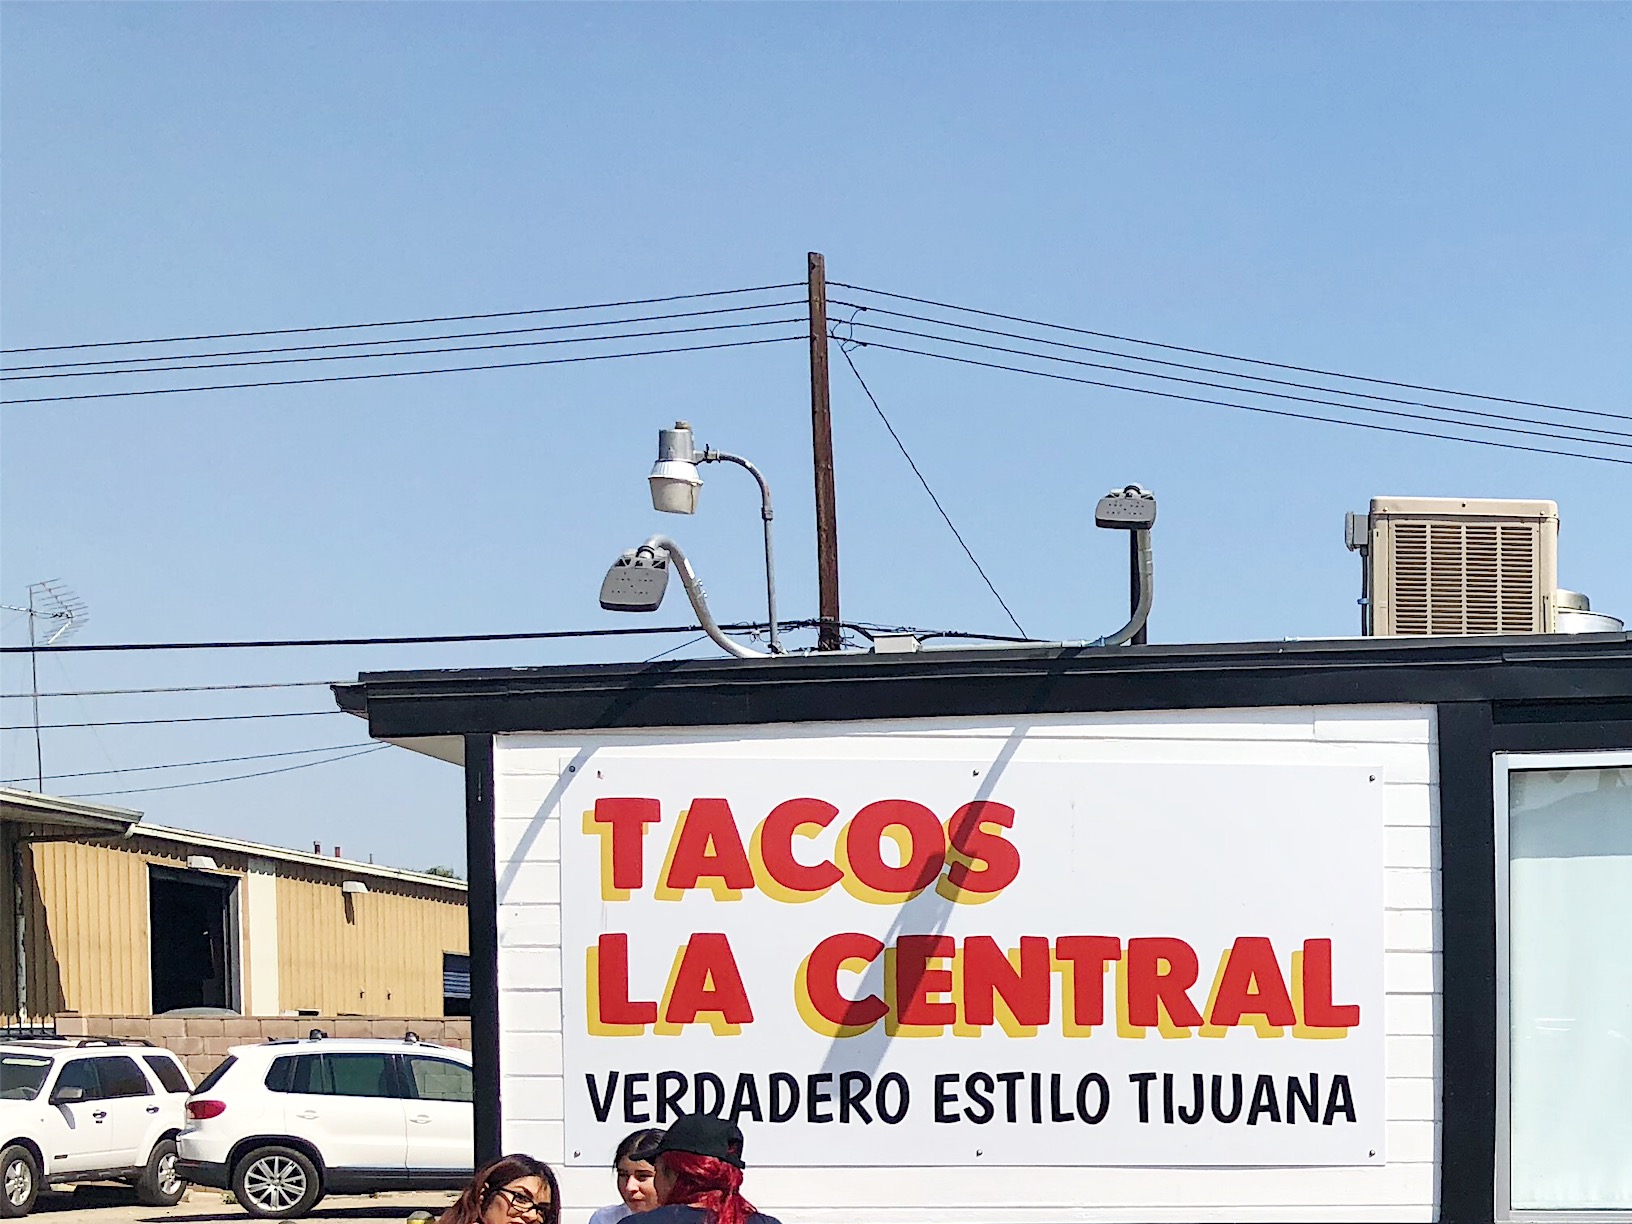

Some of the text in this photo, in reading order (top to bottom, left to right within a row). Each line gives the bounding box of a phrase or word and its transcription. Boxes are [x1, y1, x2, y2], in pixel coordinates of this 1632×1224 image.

[583, 797, 1021, 904] TACOS
[585, 932, 1361, 1039] LA CENTRAL
[585, 1070, 1357, 1126] VERDADERO ESTILO TIJUANA
